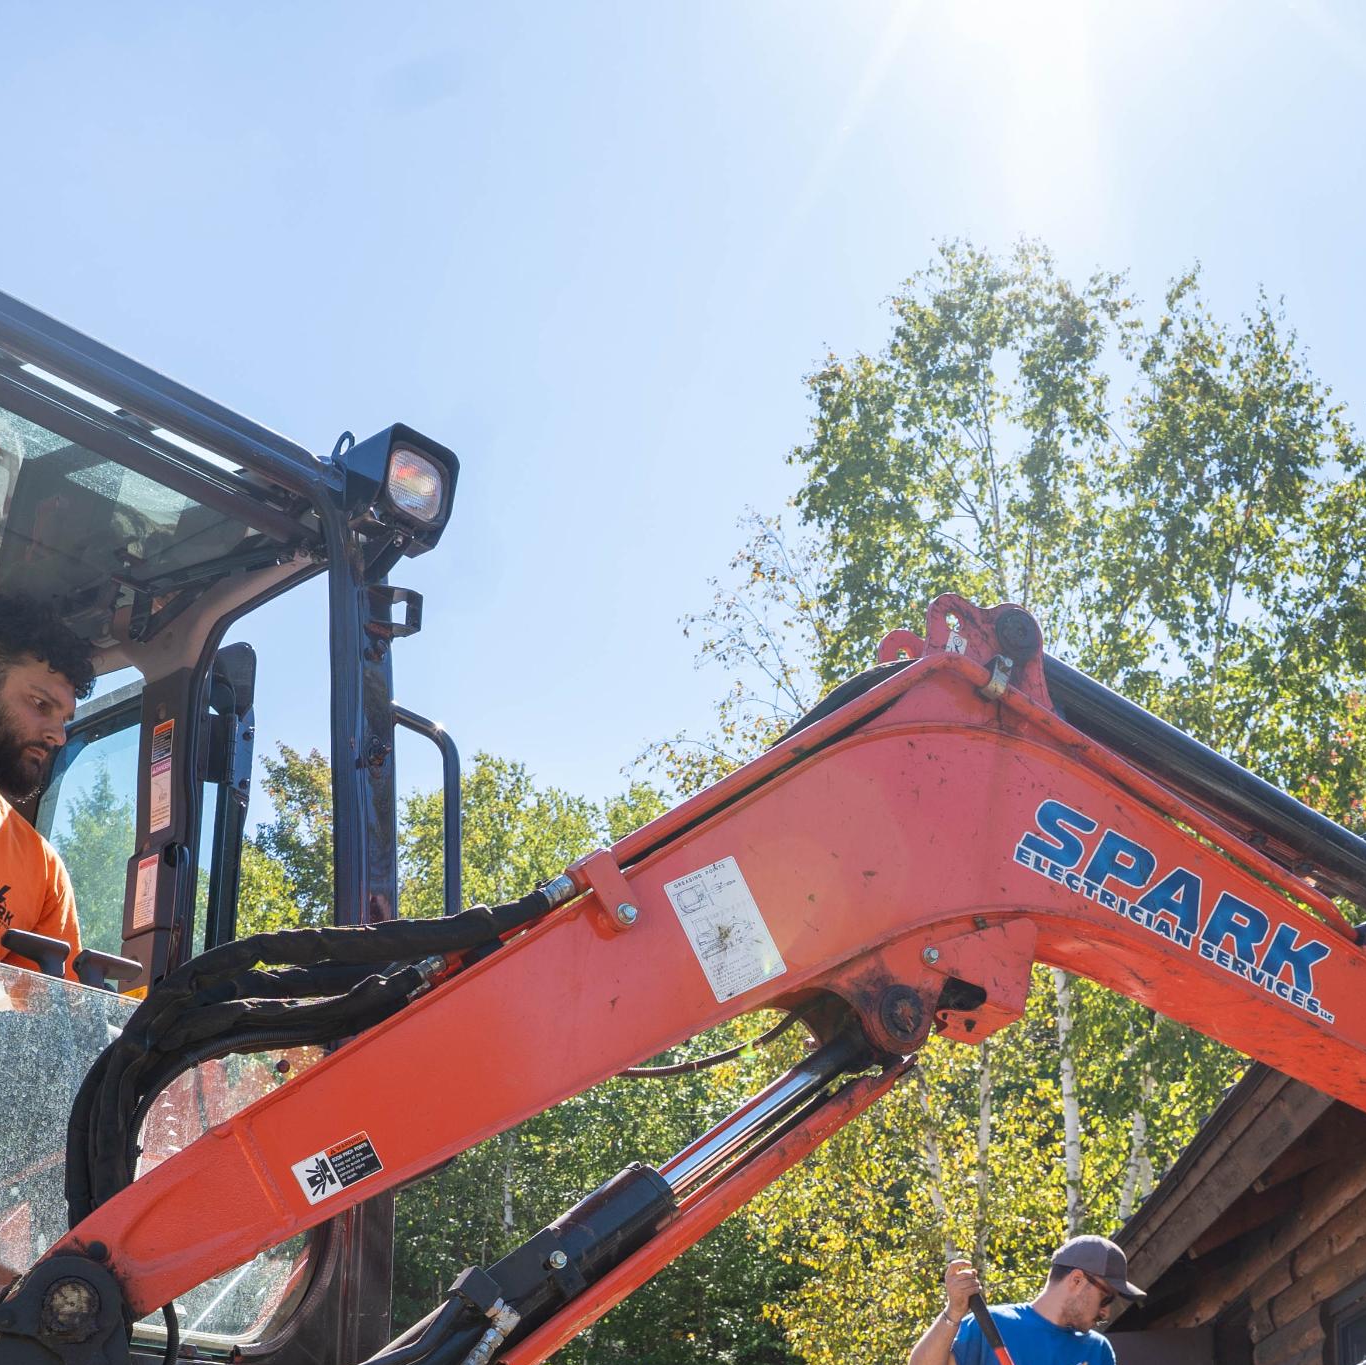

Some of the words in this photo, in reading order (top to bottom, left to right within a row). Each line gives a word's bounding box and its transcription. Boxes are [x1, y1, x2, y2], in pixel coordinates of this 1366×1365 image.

[673, 873, 702, 889] GREASING
[1013, 843, 1193, 950] ELECTRICIAN
[1198, 938, 1320, 1015] SERVICES
[1019, 799, 1332, 995] SPARK
